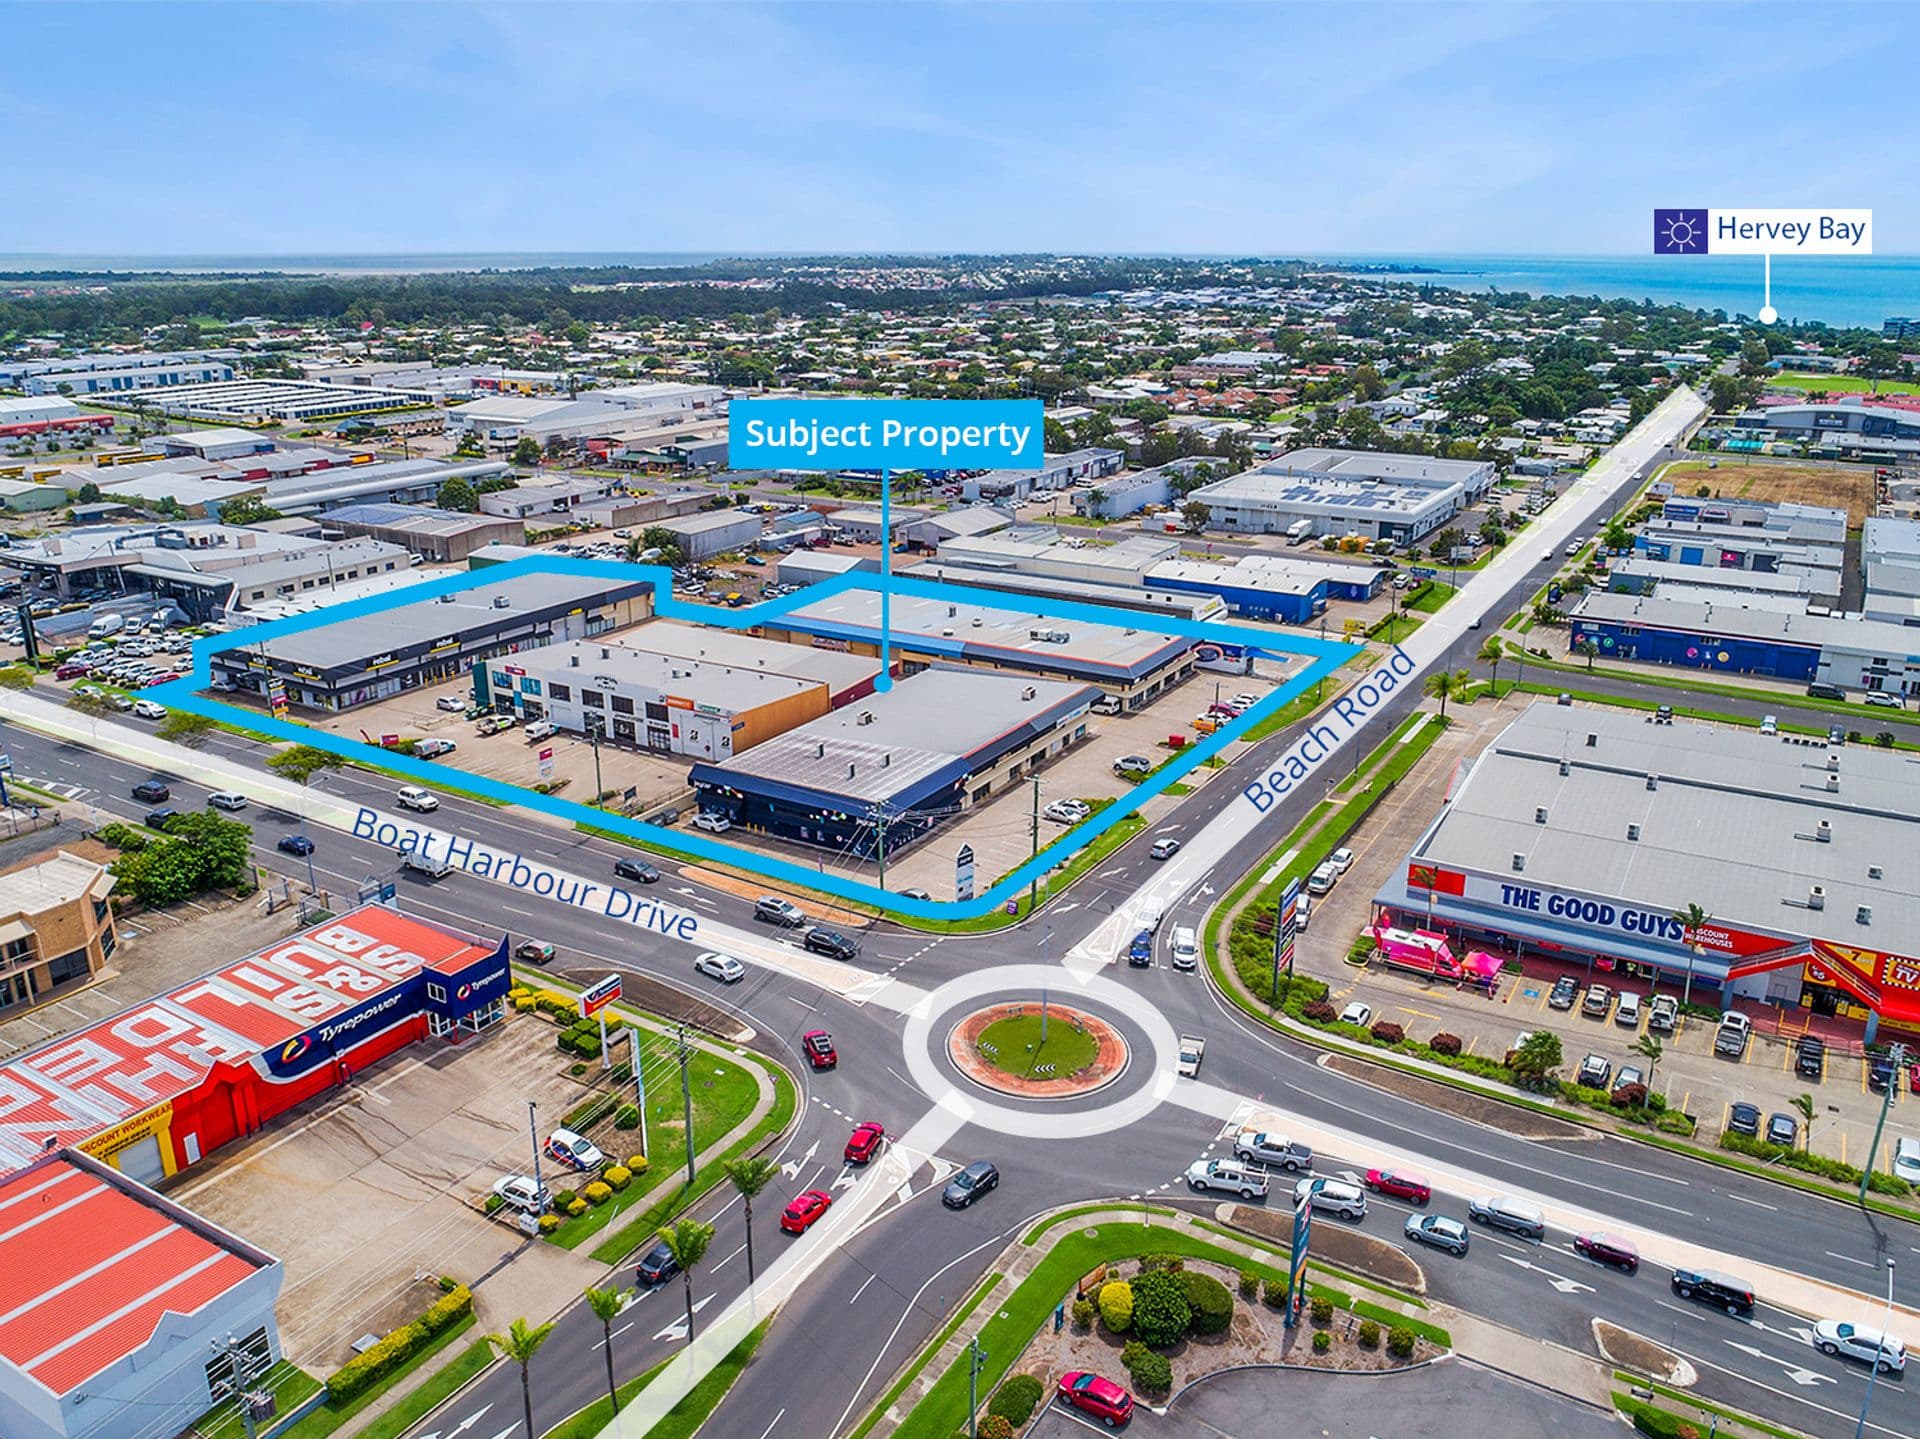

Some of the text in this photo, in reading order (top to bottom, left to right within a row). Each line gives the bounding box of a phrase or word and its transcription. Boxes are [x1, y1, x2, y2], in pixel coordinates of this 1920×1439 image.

[1501, 884, 1684, 940] THE GOOD GUYS
[1690, 927, 1730, 940] SCOUNT
[318, 993, 402, 1042] Tyrepower
[121, 1103, 173, 1134] WORKWEAR
